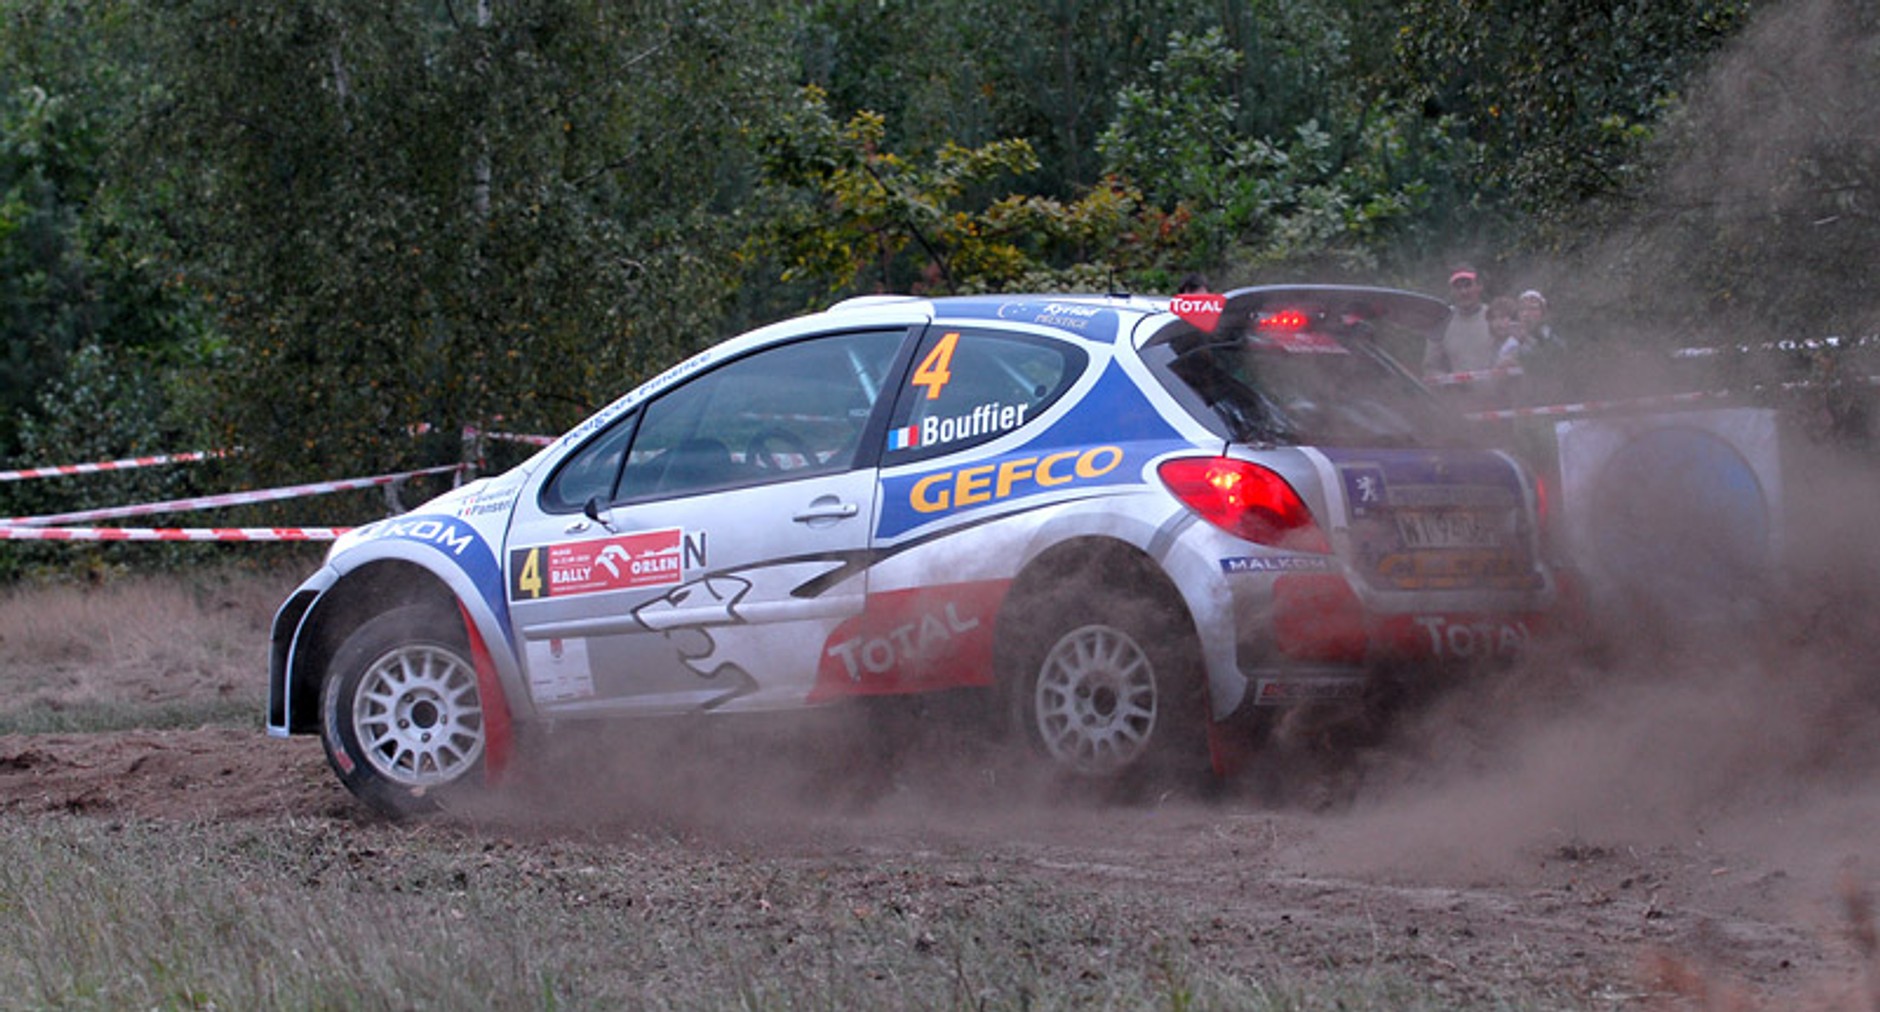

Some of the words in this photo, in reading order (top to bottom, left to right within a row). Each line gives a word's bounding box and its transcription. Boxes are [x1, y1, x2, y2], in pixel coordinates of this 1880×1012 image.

[1172, 298, 1223, 313] TOTAL
[912, 333, 960, 400] 4
[922, 401, 1028, 447] Bouffier
[909, 445, 1124, 513] GEFCO
[519, 547, 542, 598] 4
[551, 566, 591, 584] RALLY
[631, 556, 678, 575] ORLEN
[683, 532, 706, 570] N
[1228, 558, 1327, 571] MALKOM
[827, 602, 980, 683] TOTAL
